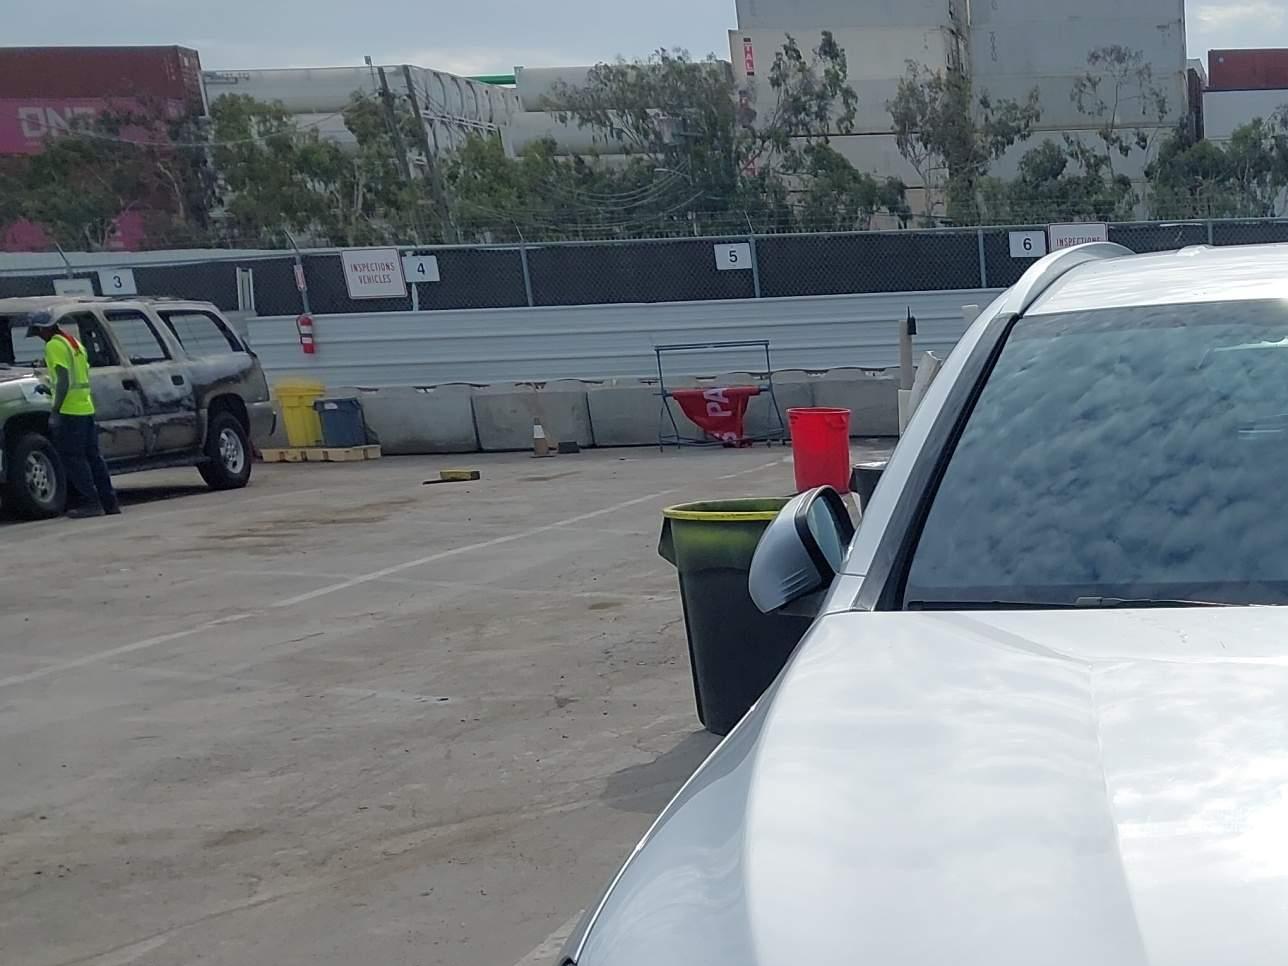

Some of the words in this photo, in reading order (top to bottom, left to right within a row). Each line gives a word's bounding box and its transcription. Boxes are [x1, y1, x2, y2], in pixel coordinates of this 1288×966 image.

[1022, 238, 1033, 251] 6
[729, 250, 738, 263] 5
[350, 262, 396, 273] INSPECTIONS
[417, 262, 426, 275] 4
[112, 275, 123, 289] 3
[358, 274, 392, 285] VEHICLES
